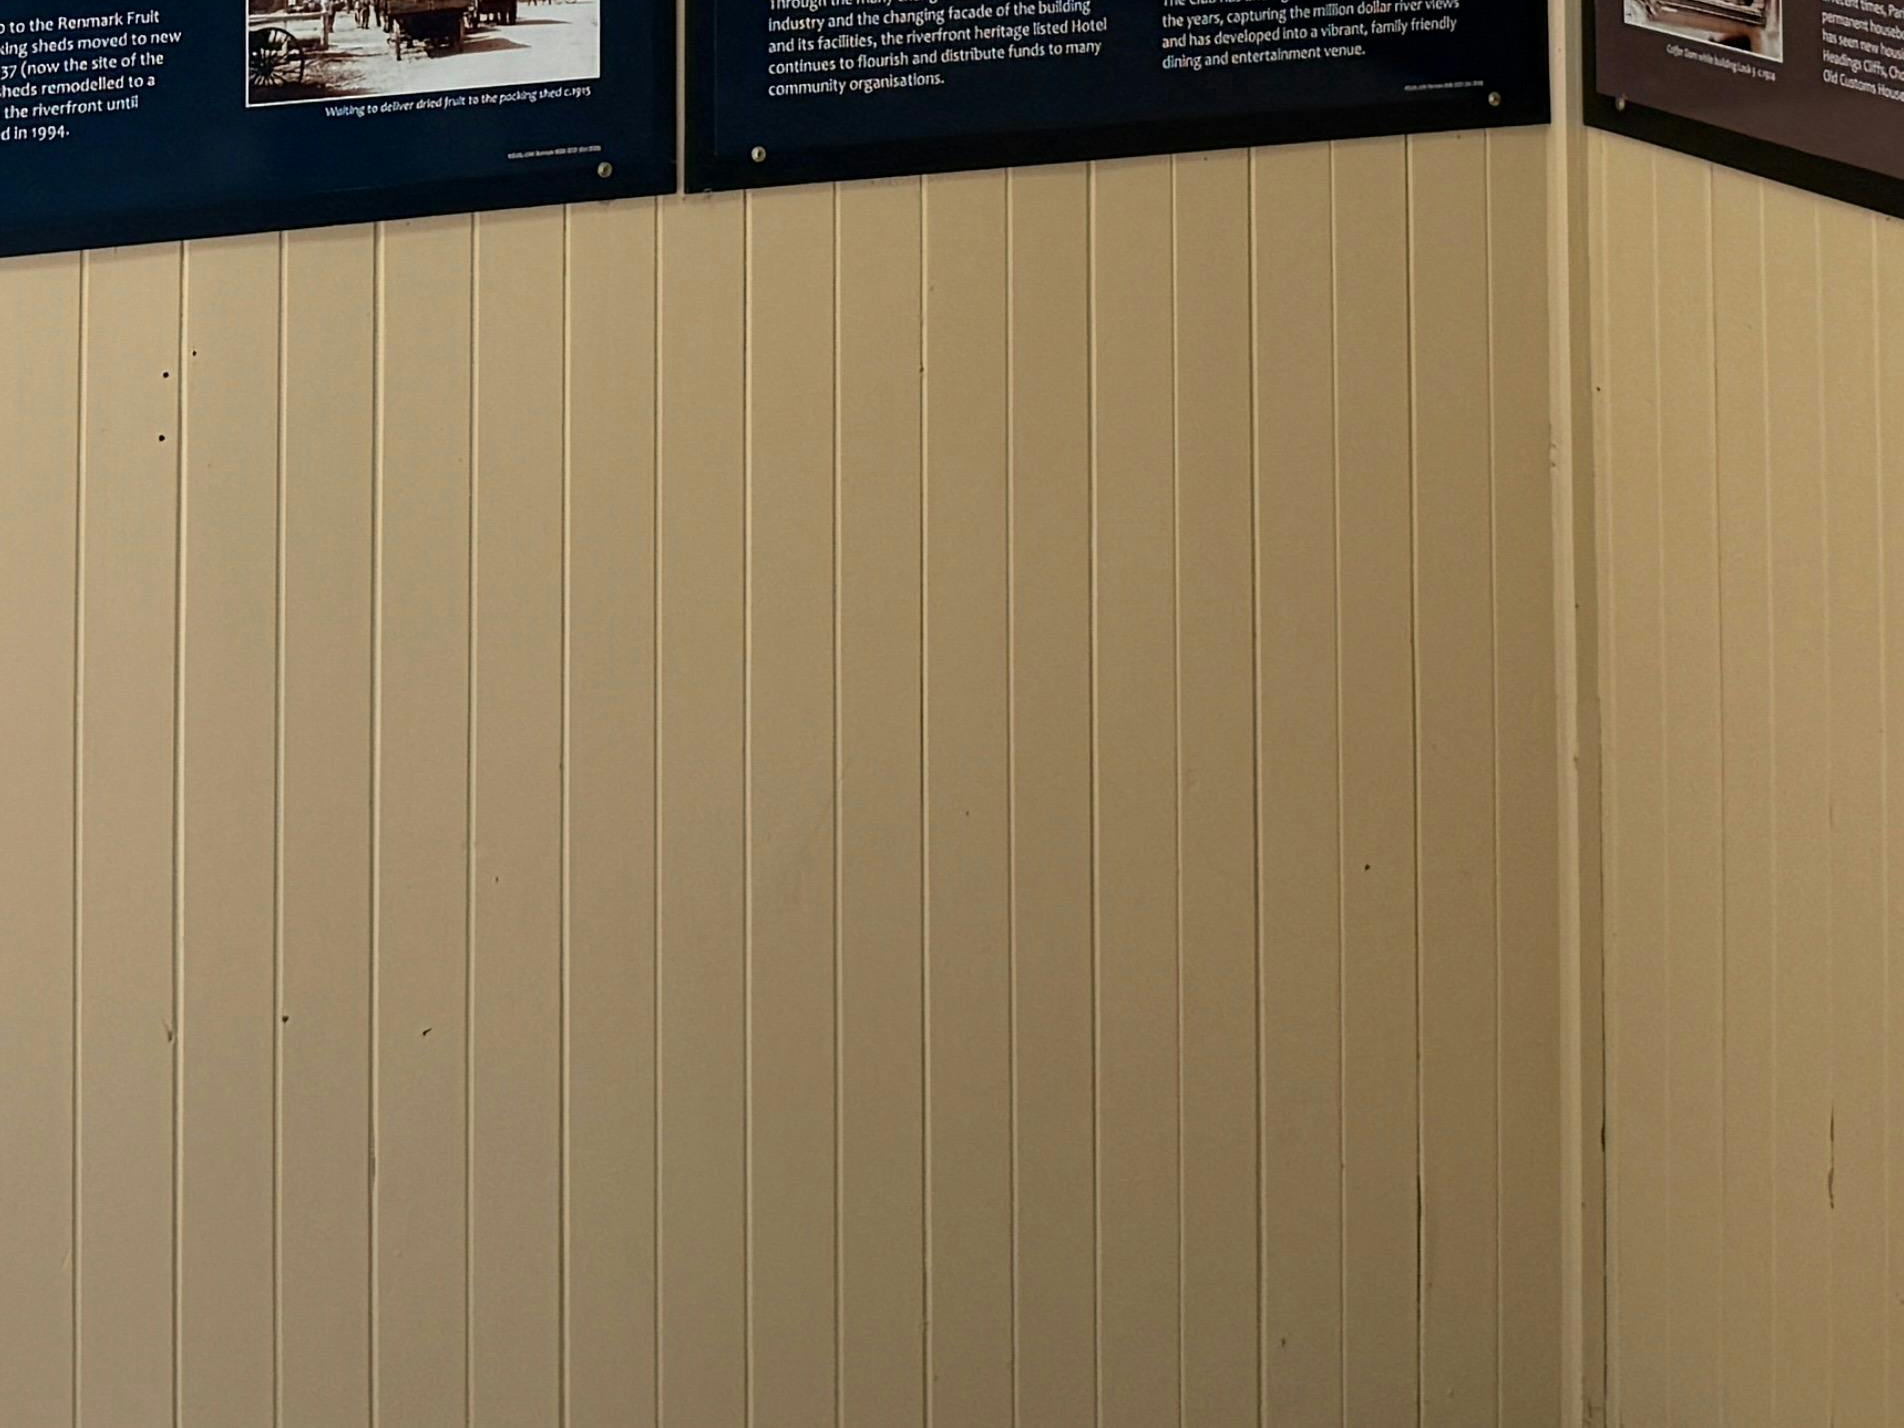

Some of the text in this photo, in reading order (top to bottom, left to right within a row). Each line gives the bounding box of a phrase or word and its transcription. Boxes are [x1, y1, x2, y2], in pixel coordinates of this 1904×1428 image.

[1161, 44, 1366, 72] dining and entertainment venue.
[13, 125, 28, 140] in
[31, 124, 70, 142] 1994.
